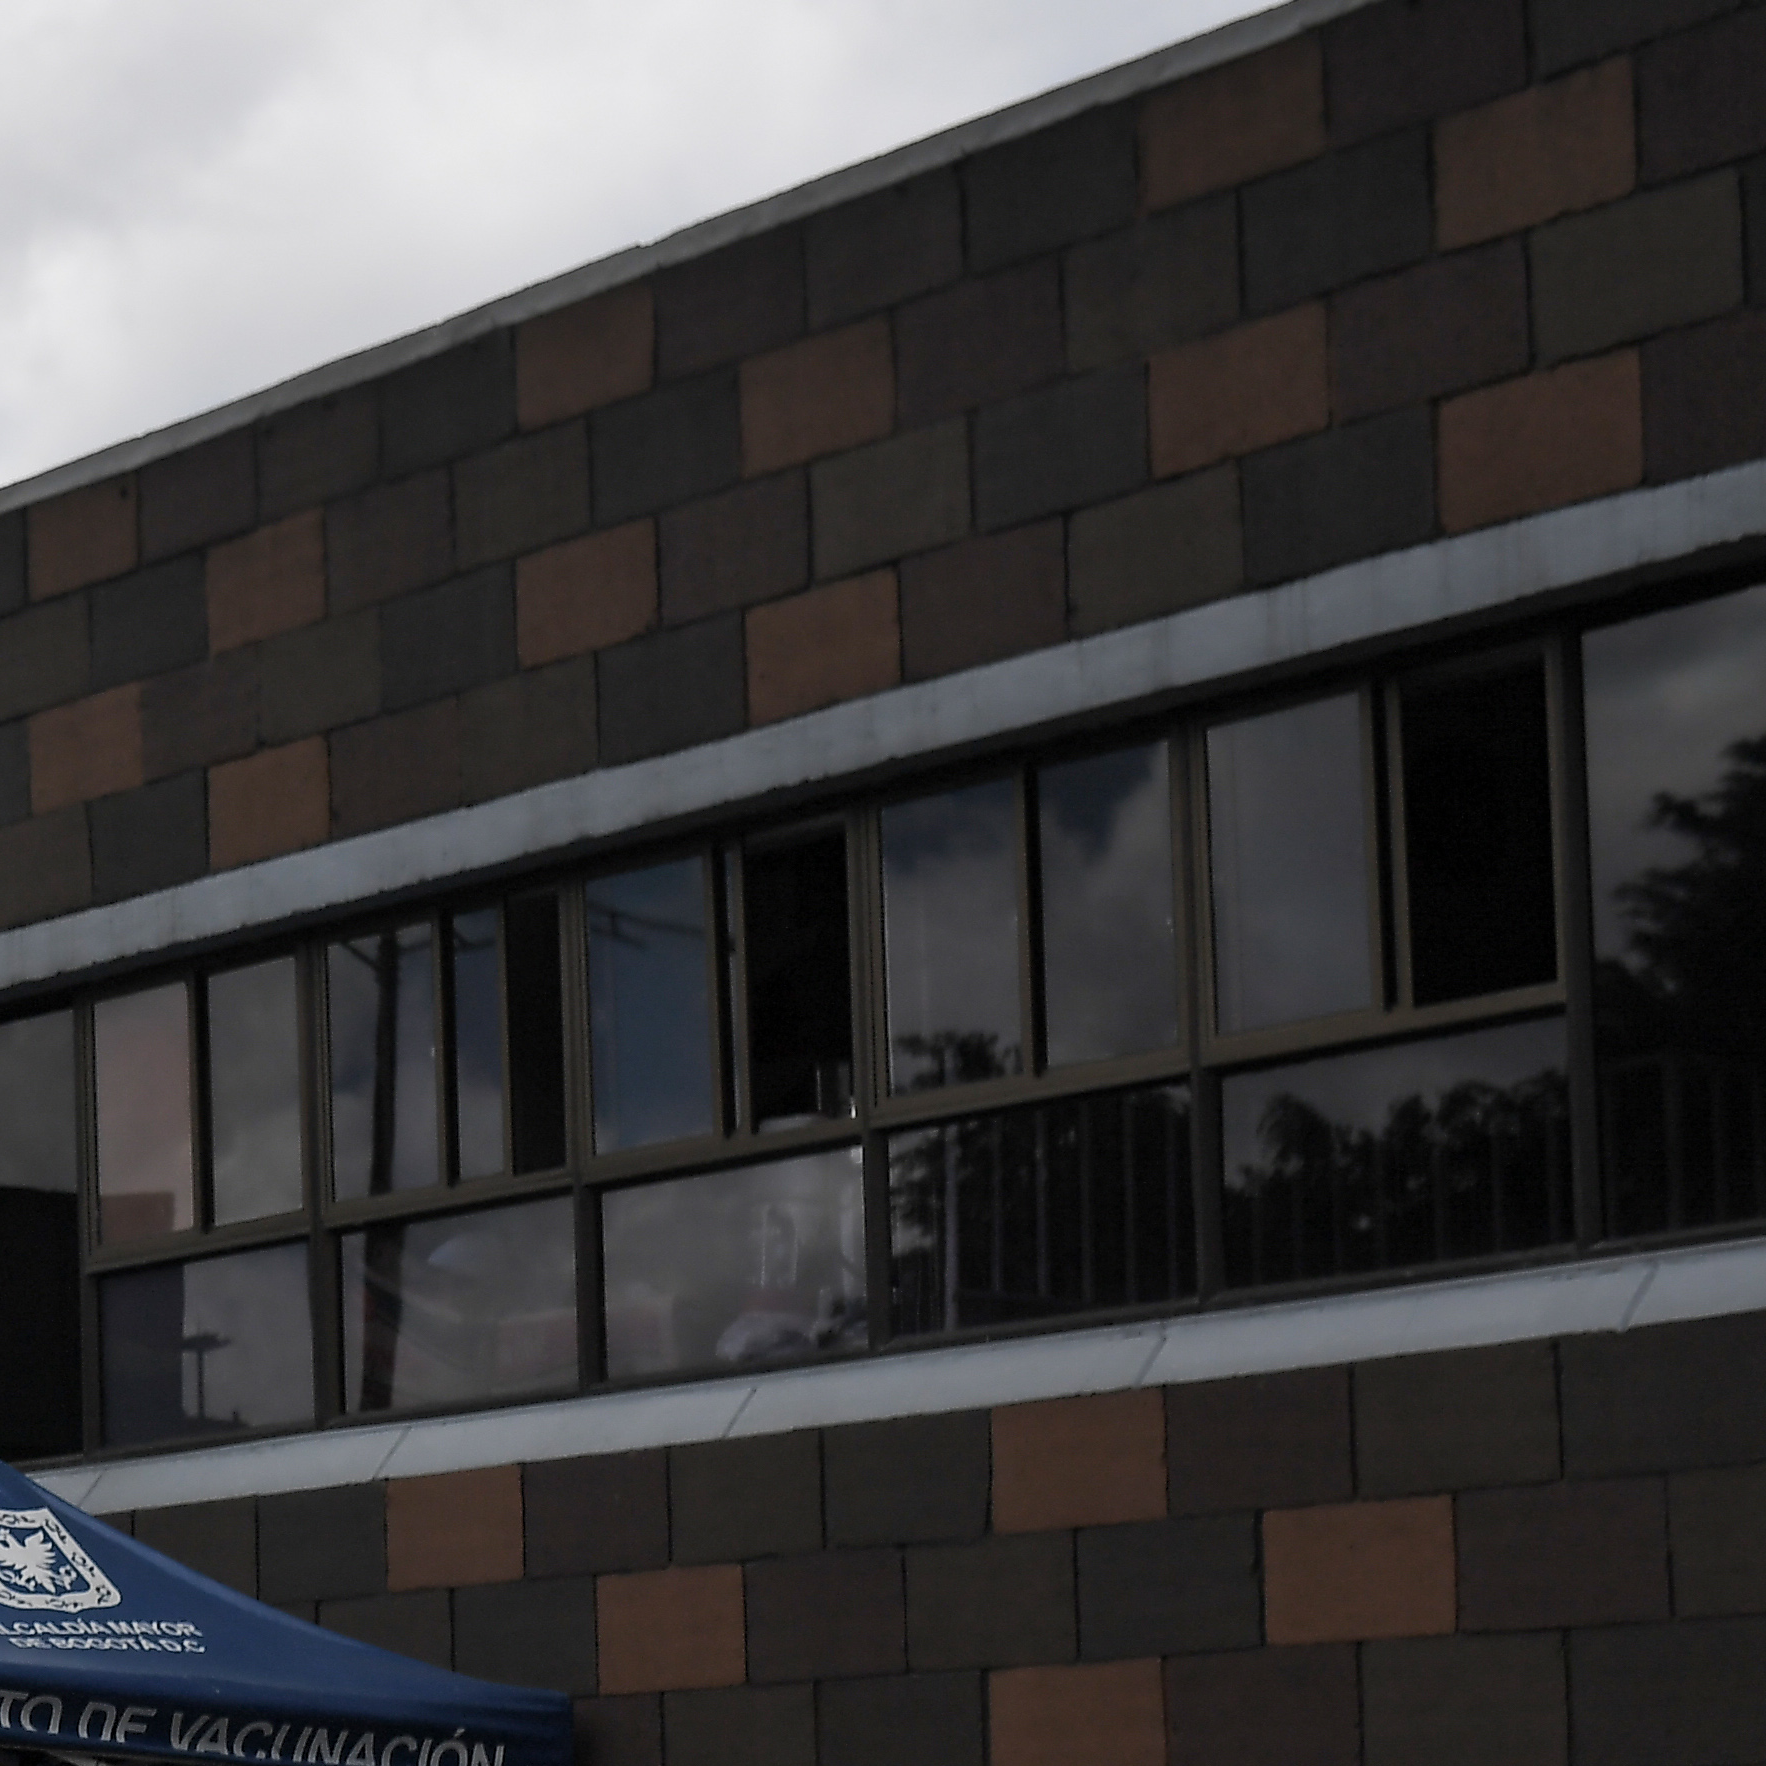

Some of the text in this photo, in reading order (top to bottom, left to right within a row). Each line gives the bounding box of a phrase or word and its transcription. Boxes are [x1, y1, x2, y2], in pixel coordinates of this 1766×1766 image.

[107, 1621, 203, 1637] MAYOR
[9, 1637, 52, 1649] DE
[78, 1701, 157, 1743] DE
